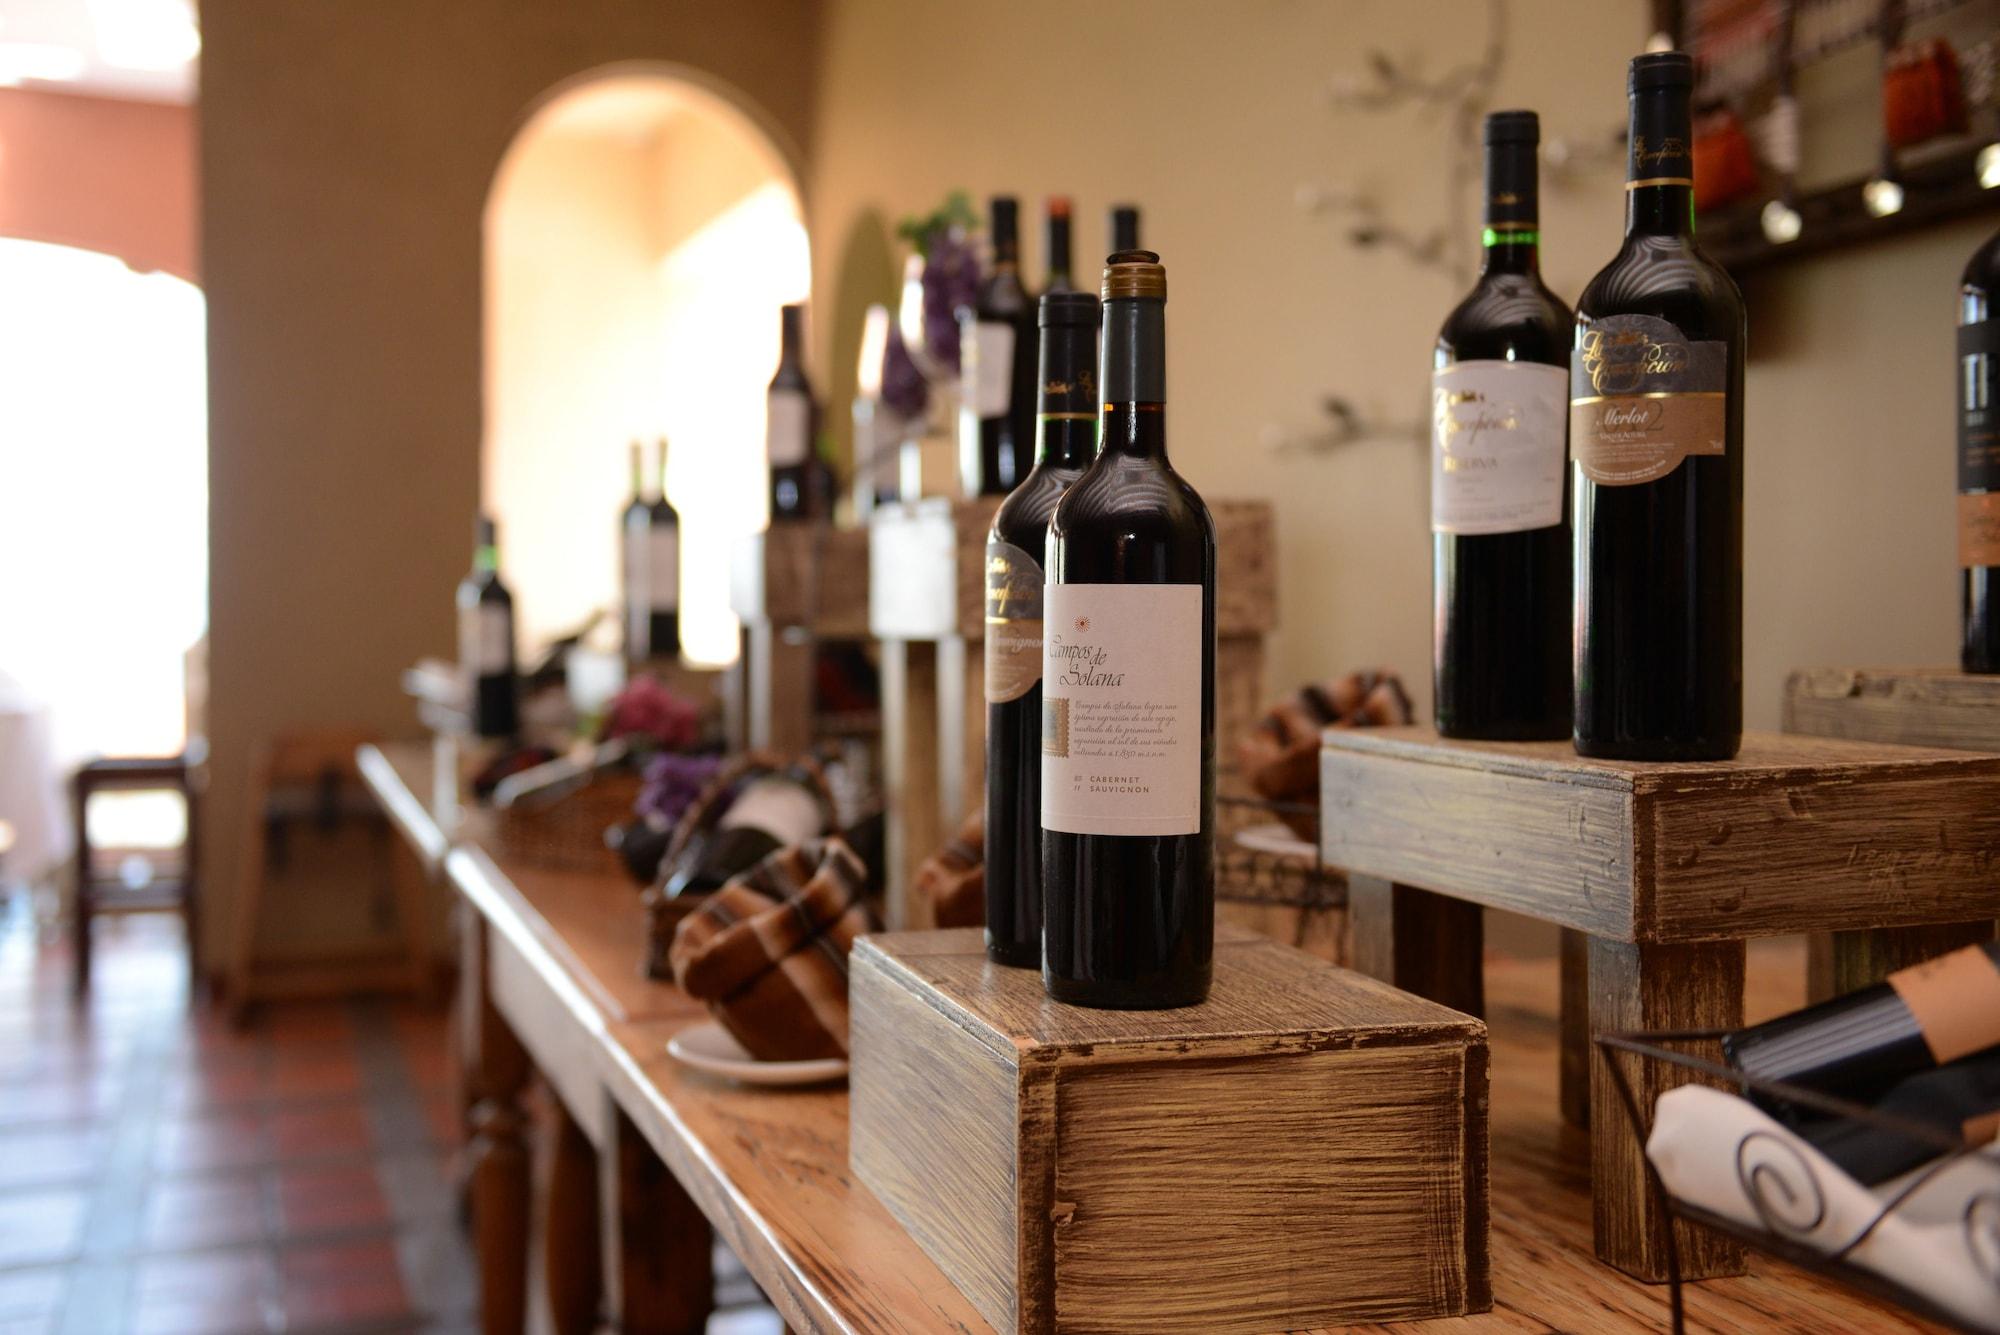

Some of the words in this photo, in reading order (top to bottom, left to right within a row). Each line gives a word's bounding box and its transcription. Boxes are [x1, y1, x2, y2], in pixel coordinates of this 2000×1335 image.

[1594, 405, 1649, 425] Merlot
[1049, 634, 1093, 666] Campos
[1089, 647, 1108, 666] de
[1060, 663, 1125, 687] Solana
[1090, 775, 1140, 784] CABERNET
[1090, 785, 1149, 793] SAUVIGNON
